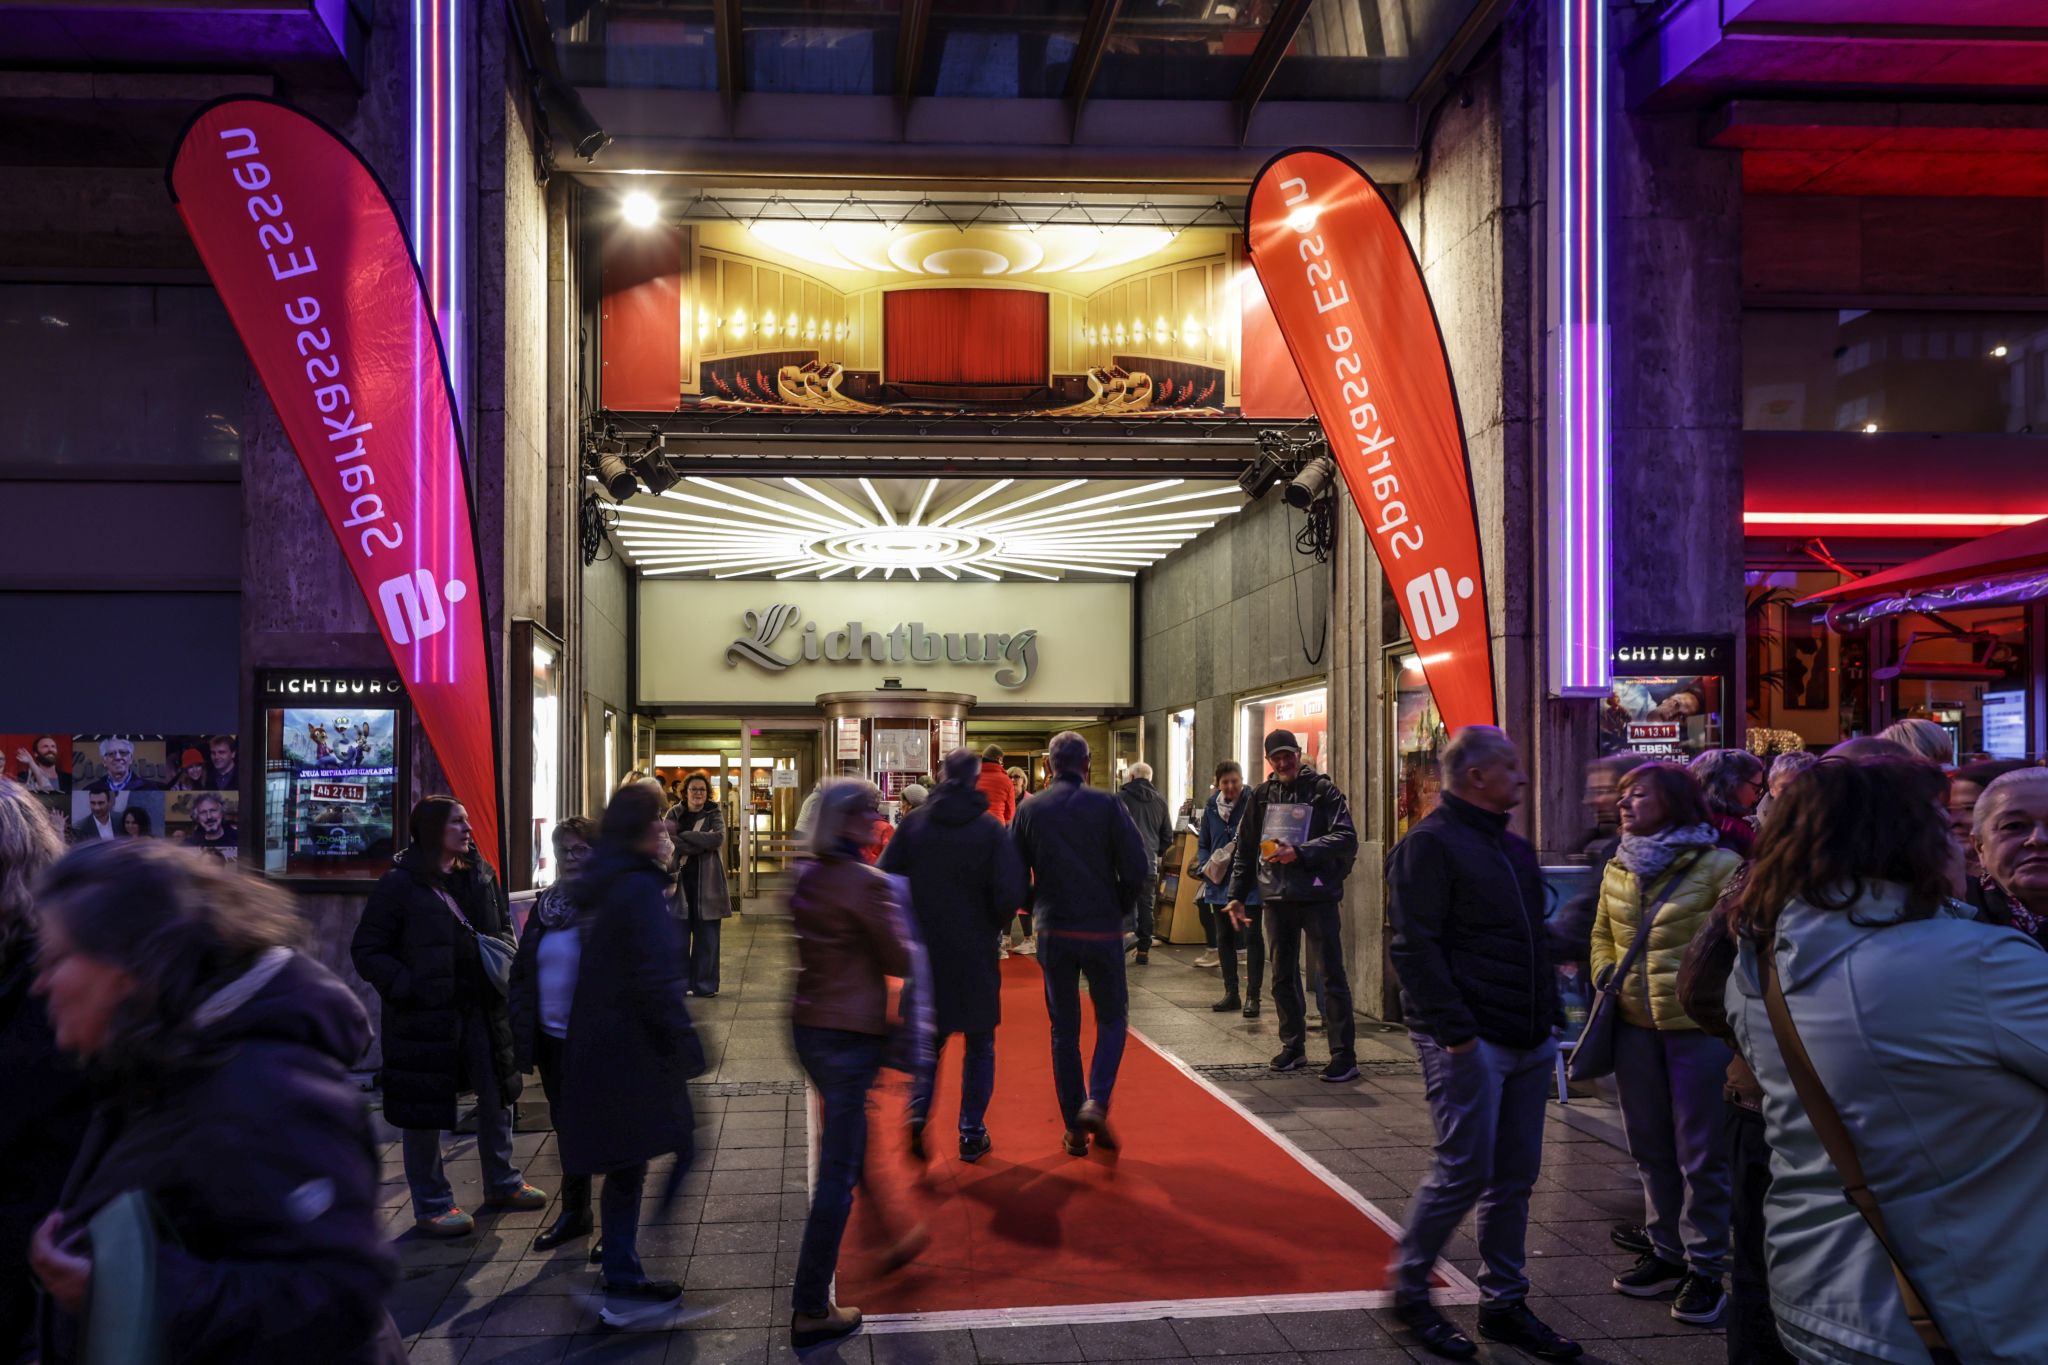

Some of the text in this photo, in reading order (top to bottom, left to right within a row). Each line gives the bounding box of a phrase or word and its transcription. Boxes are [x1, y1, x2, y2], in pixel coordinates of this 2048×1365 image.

[724, 604, 1039, 689] Lichtburg
[266, 679, 400, 693] LICHTBURG
[1633, 727, 1673, 737] Ab 13.11.
[1632, 744, 1672, 754] LEBEN
[317, 785, 361, 799] Ab 27.11.
